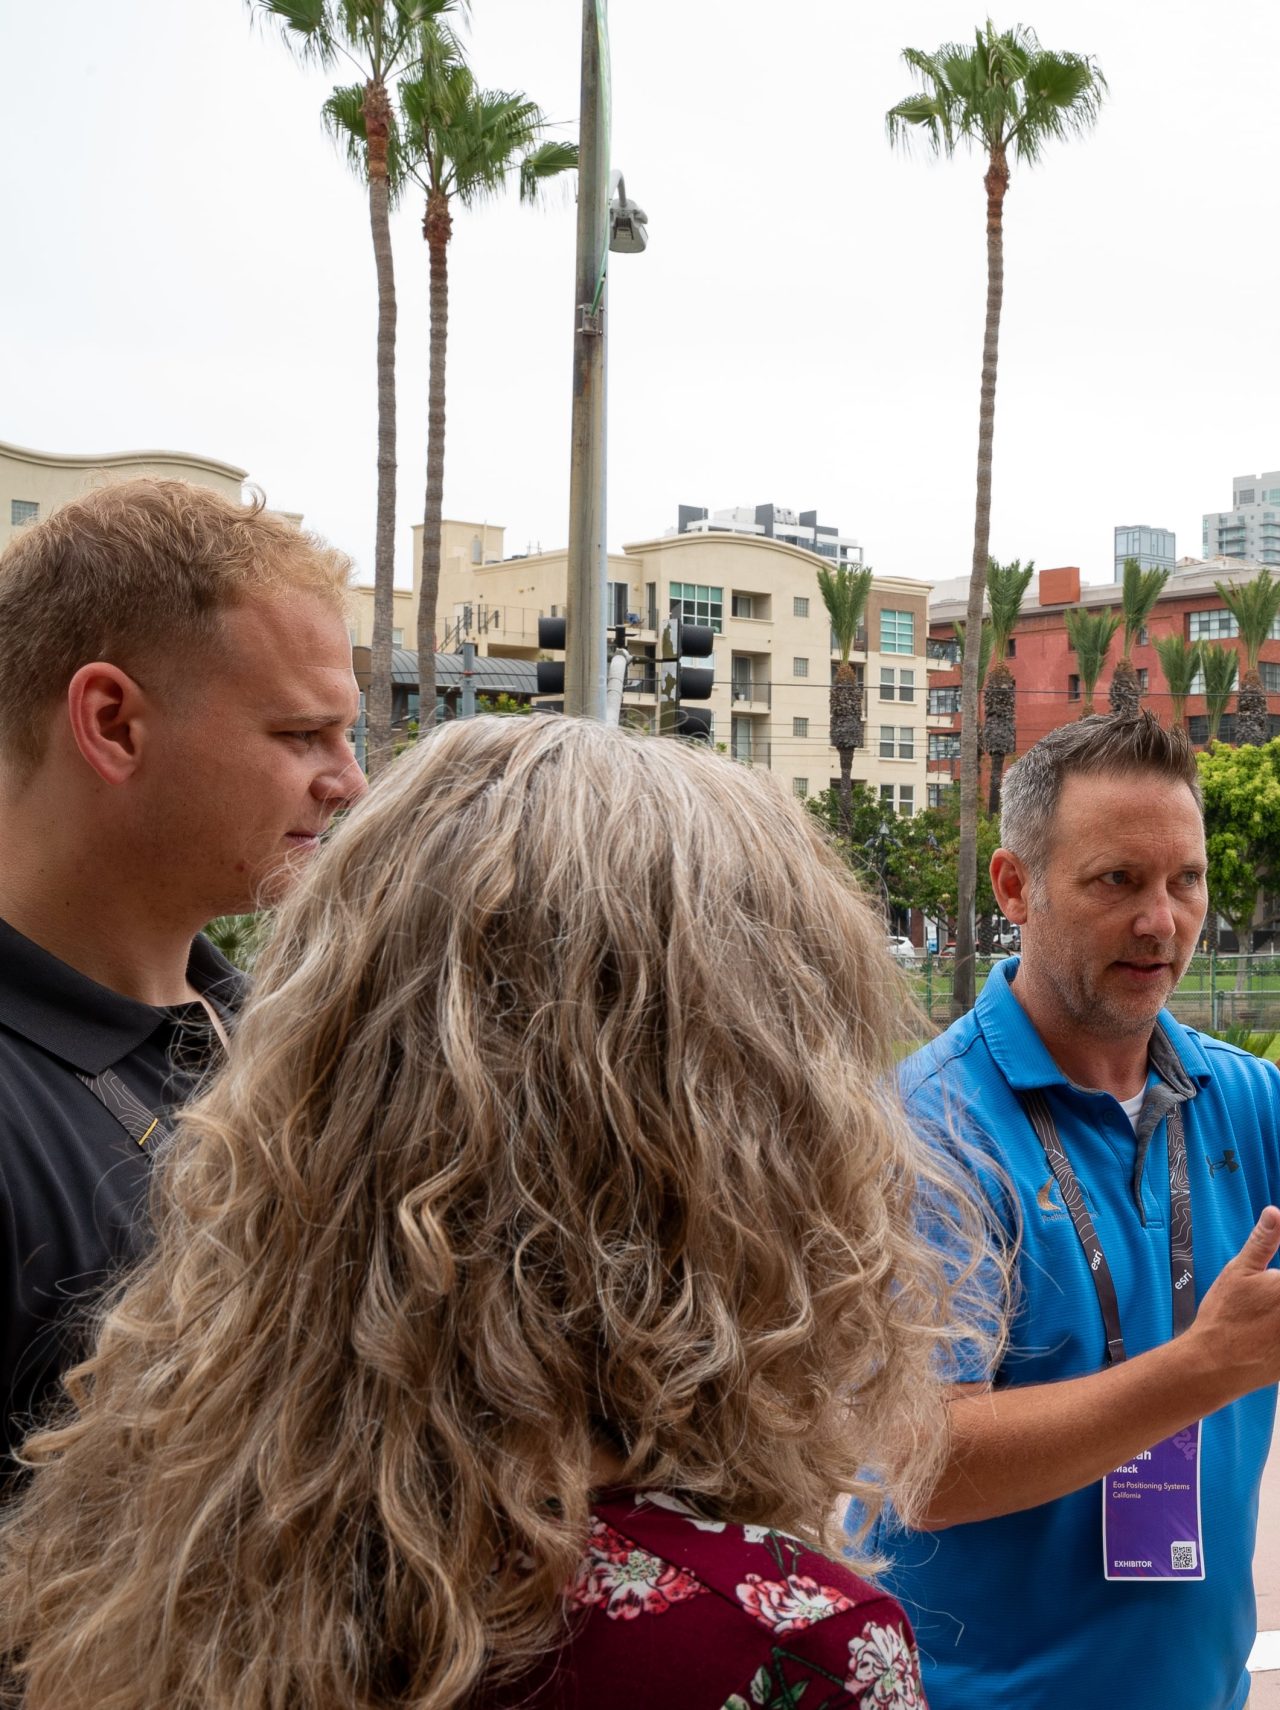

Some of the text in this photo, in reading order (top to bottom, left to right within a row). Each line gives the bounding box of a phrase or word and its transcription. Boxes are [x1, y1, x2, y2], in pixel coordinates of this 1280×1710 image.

[1091, 1249, 1102, 1270] esri
[1175, 1269, 1193, 1289] esri
[1112, 1481, 1190, 1491] Eos Positioning Systems
[1114, 1560, 1152, 1568] EXHIBITOR
